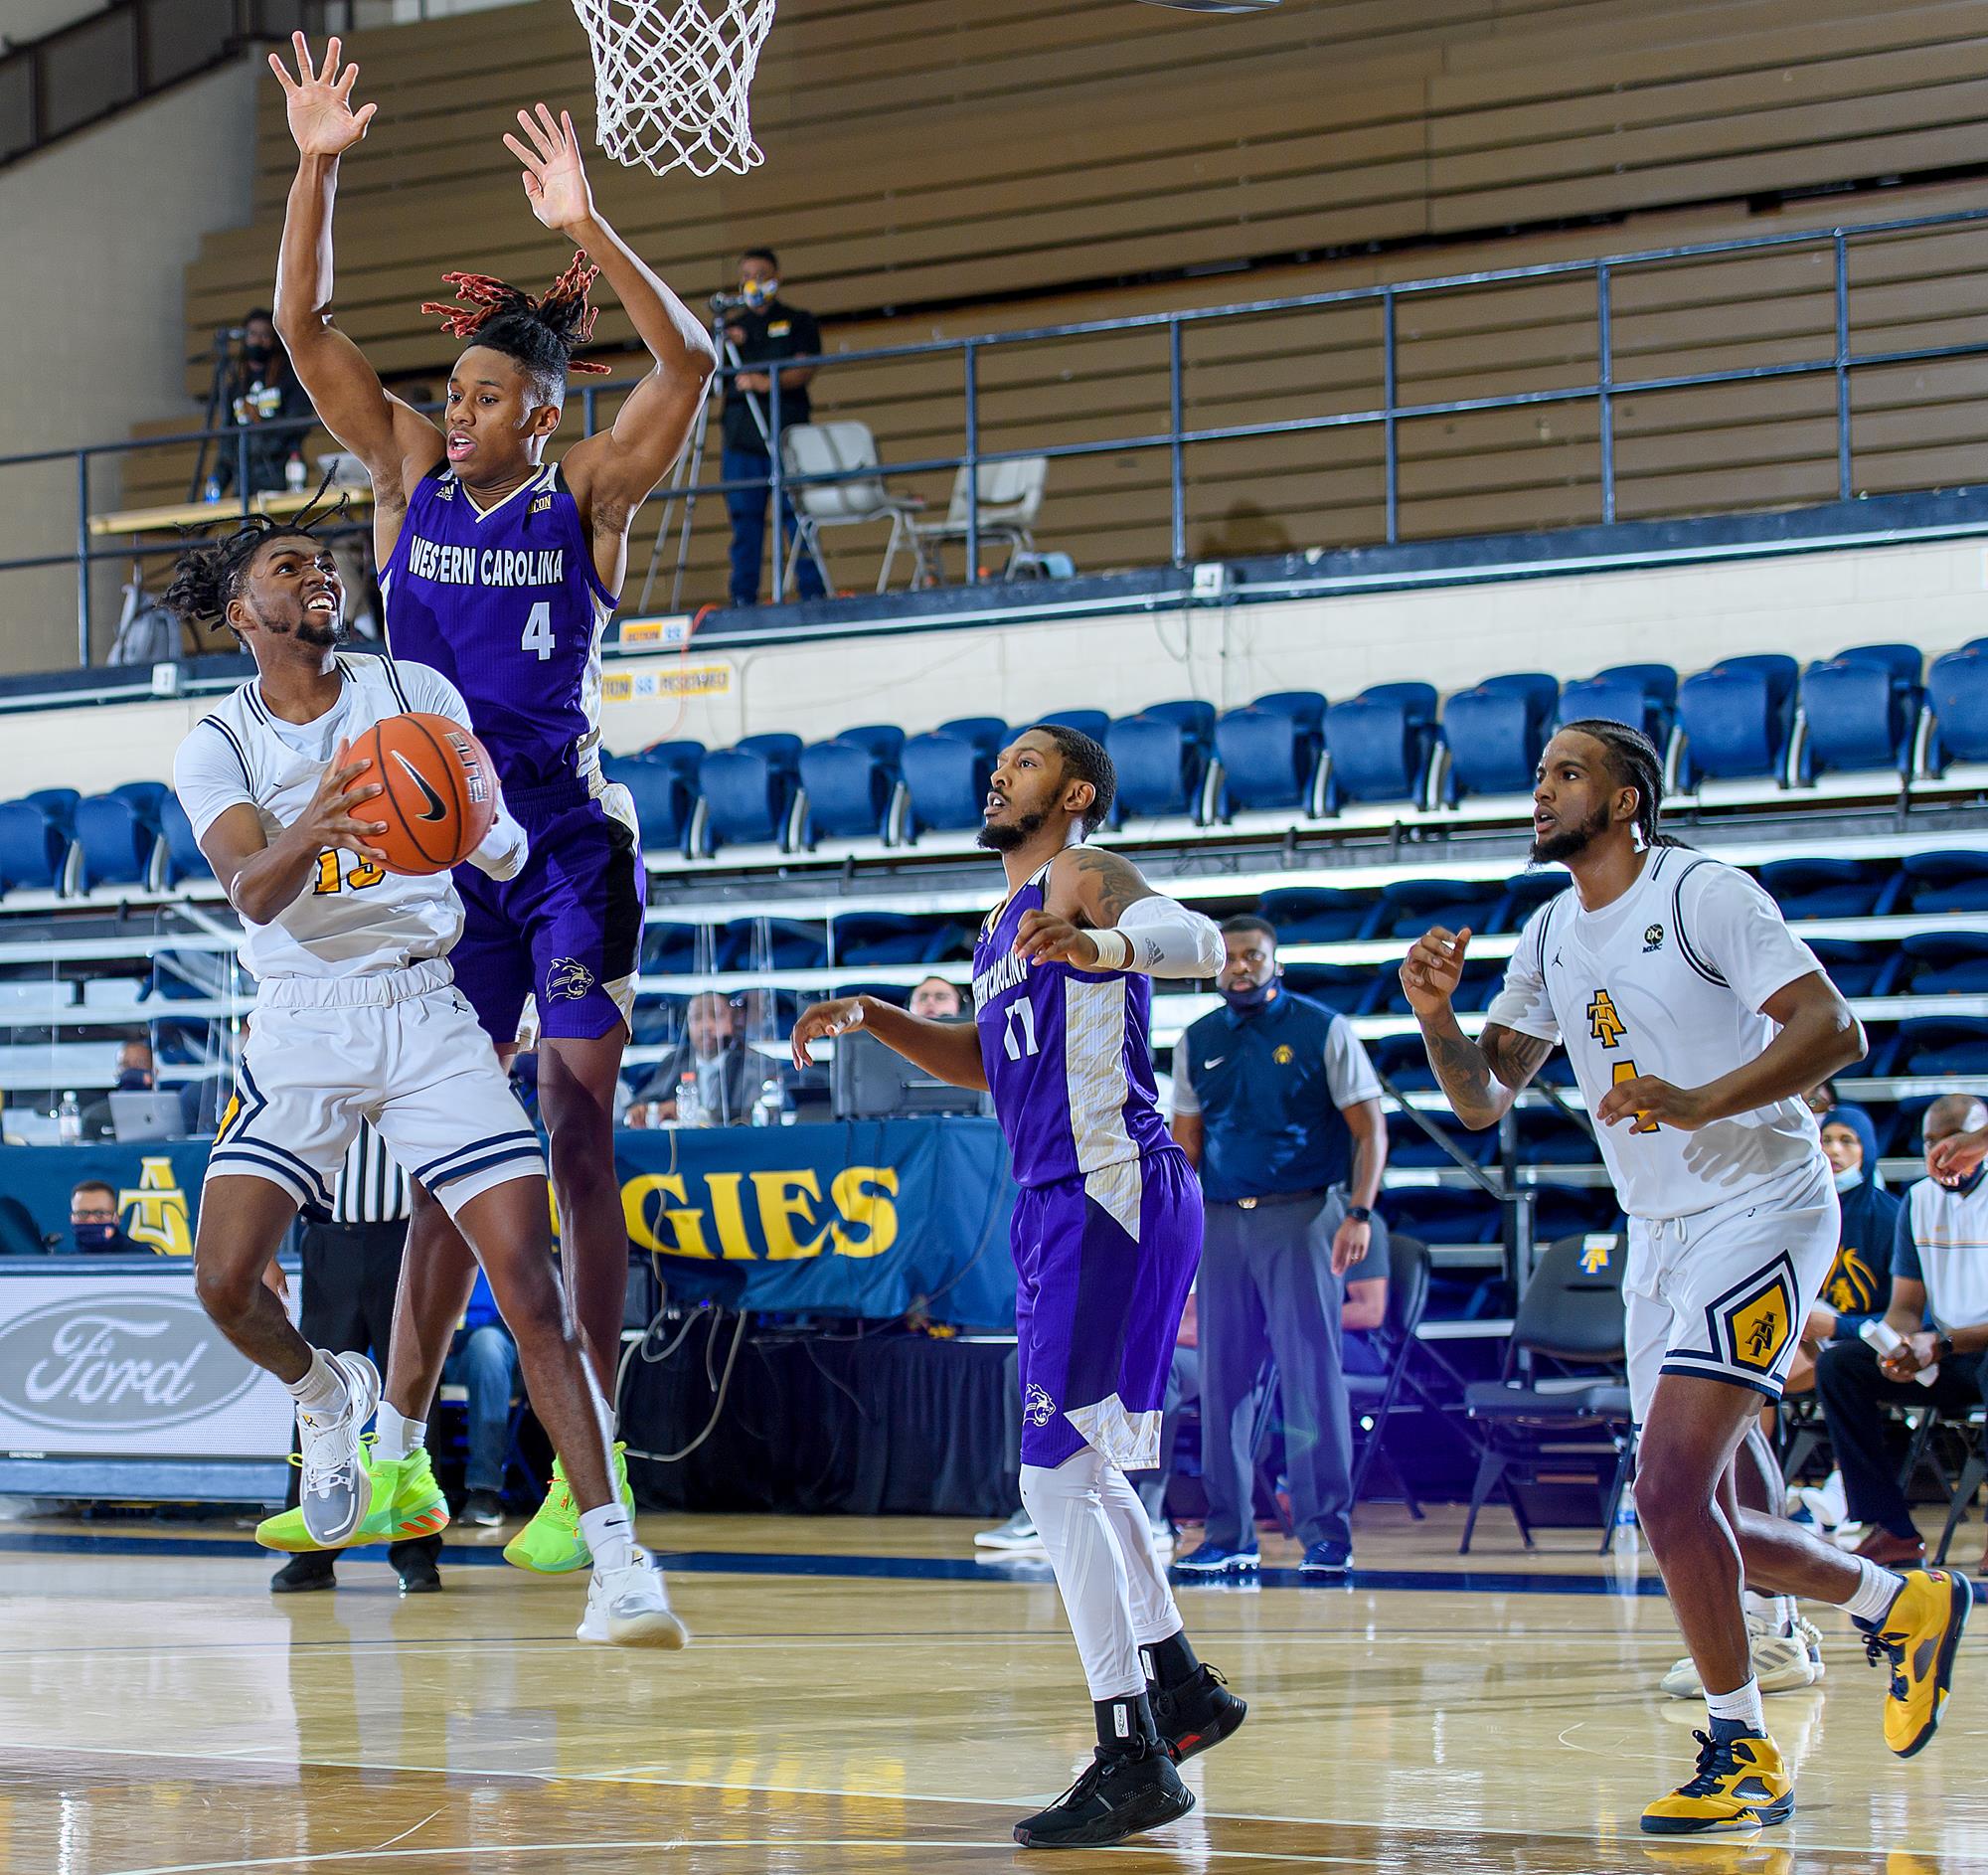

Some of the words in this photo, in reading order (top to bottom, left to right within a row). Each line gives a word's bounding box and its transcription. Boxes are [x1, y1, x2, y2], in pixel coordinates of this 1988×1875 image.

[480, 549, 564, 587] CAROLINA
[521, 601, 556, 660] 4
[24, 1314, 210, 1407] Ford
